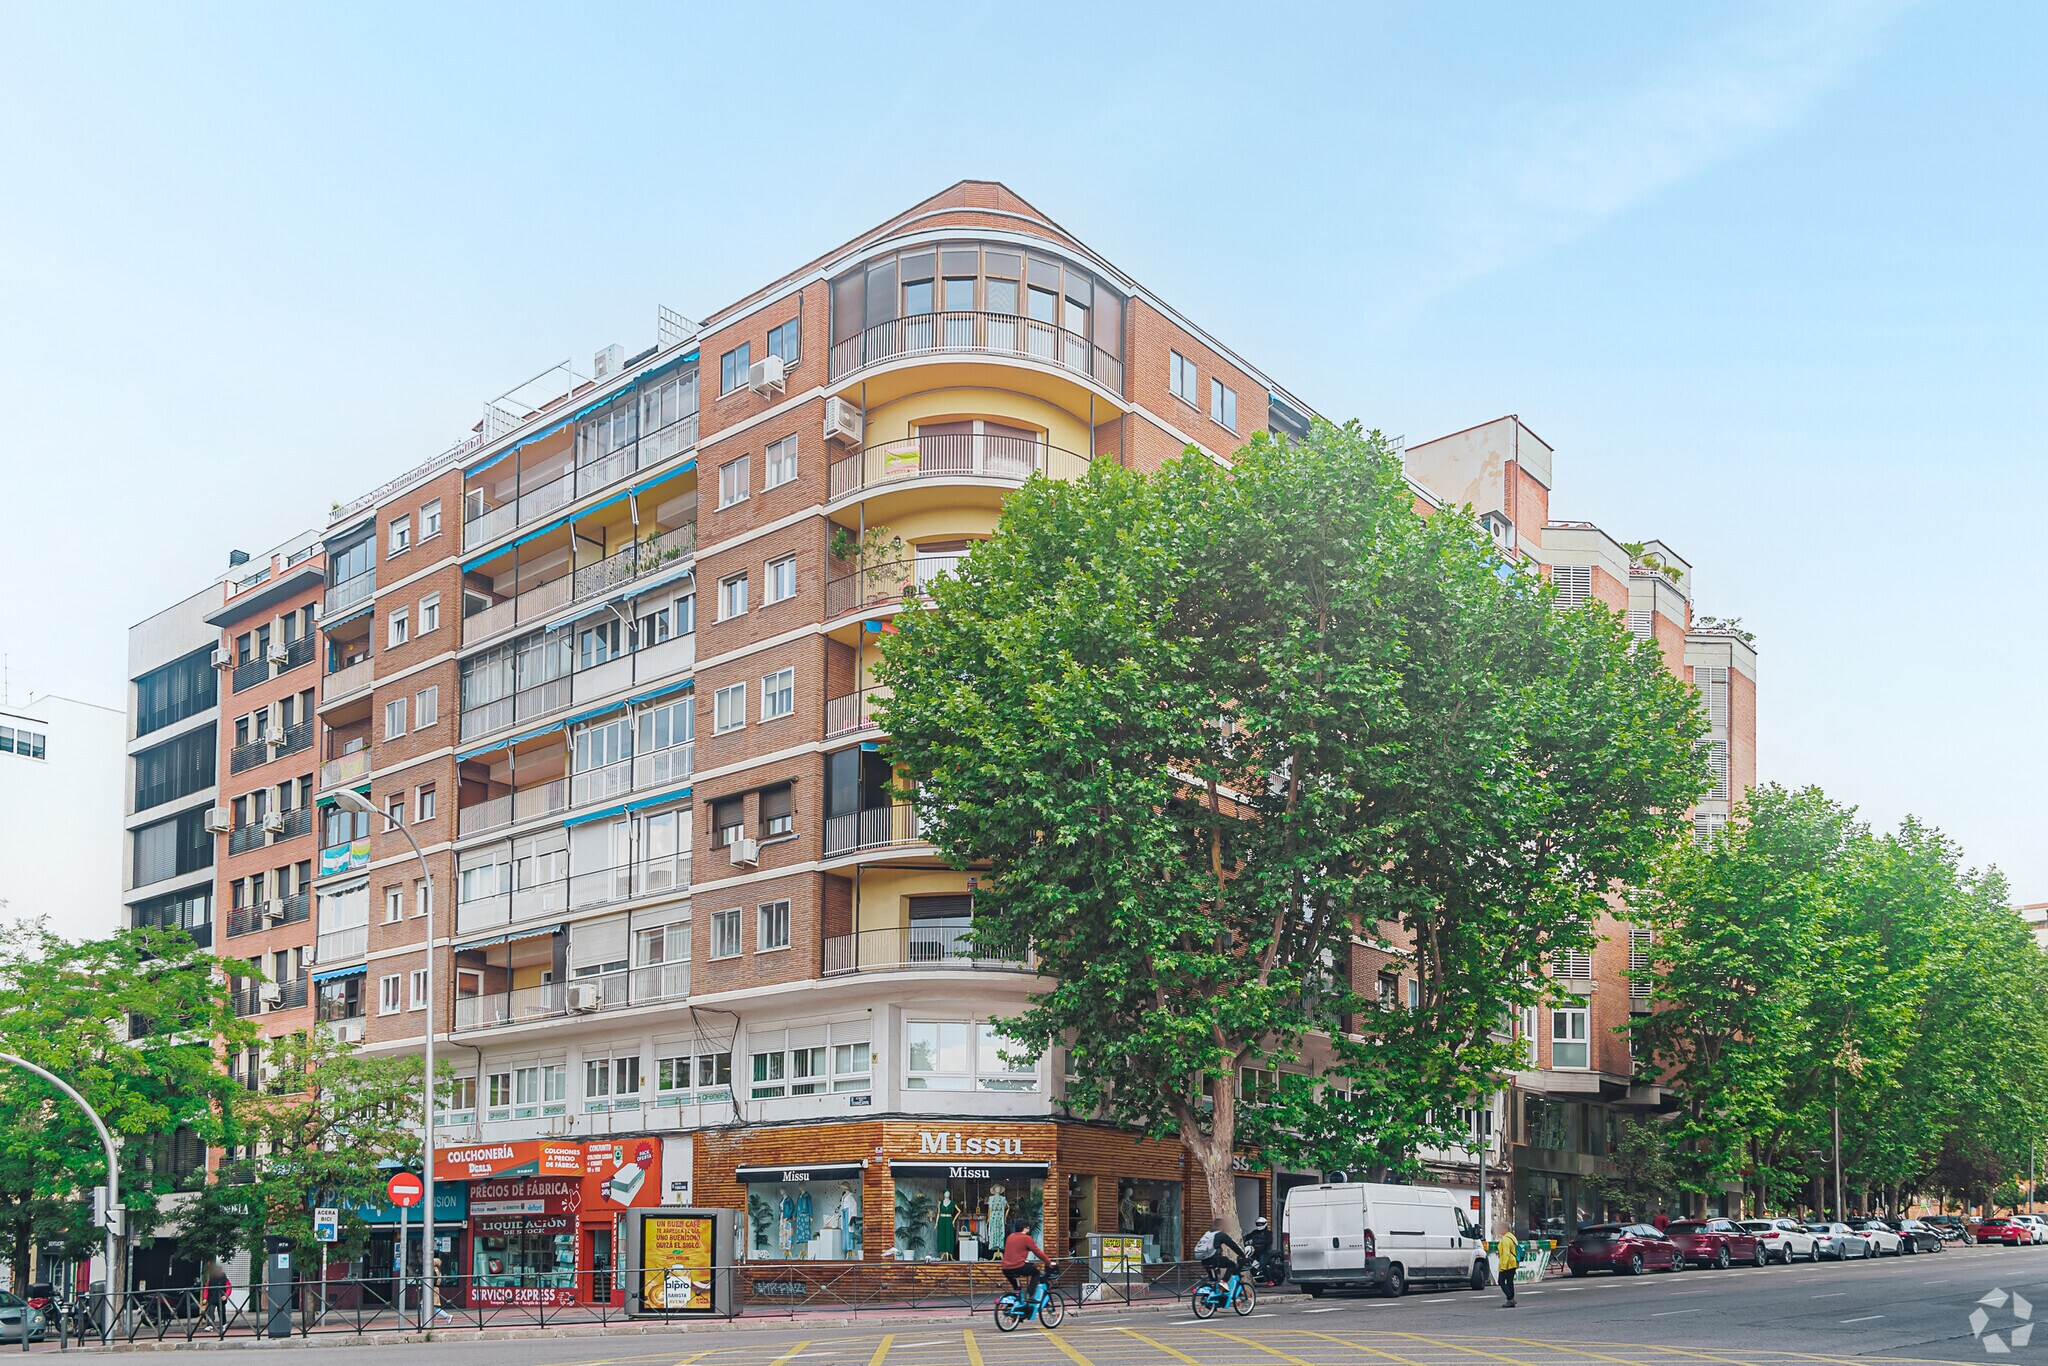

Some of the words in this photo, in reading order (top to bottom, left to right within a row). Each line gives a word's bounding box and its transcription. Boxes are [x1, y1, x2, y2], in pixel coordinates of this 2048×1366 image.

[918, 1131, 1024, 1155] Missu
[447, 1144, 514, 1164] COLCHONERÍA
[544, 1147, 580, 1156] COLCHONES
[554, 1160, 580, 1169] FÁBRICA
[782, 1170, 810, 1182] Missu
[949, 1167, 990, 1179] Missu
[470, 1184, 509, 1199] PRECIOS
[511, 1184, 524, 1197] DE
[527, 1180, 569, 1196] FÁBRICA
[656, 1220, 666, 1228] UN
[667, 1220, 685, 1228] BUEN
[685, 1219, 701, 1228] CAFÉ
[666, 1280, 690, 1291] alpro
